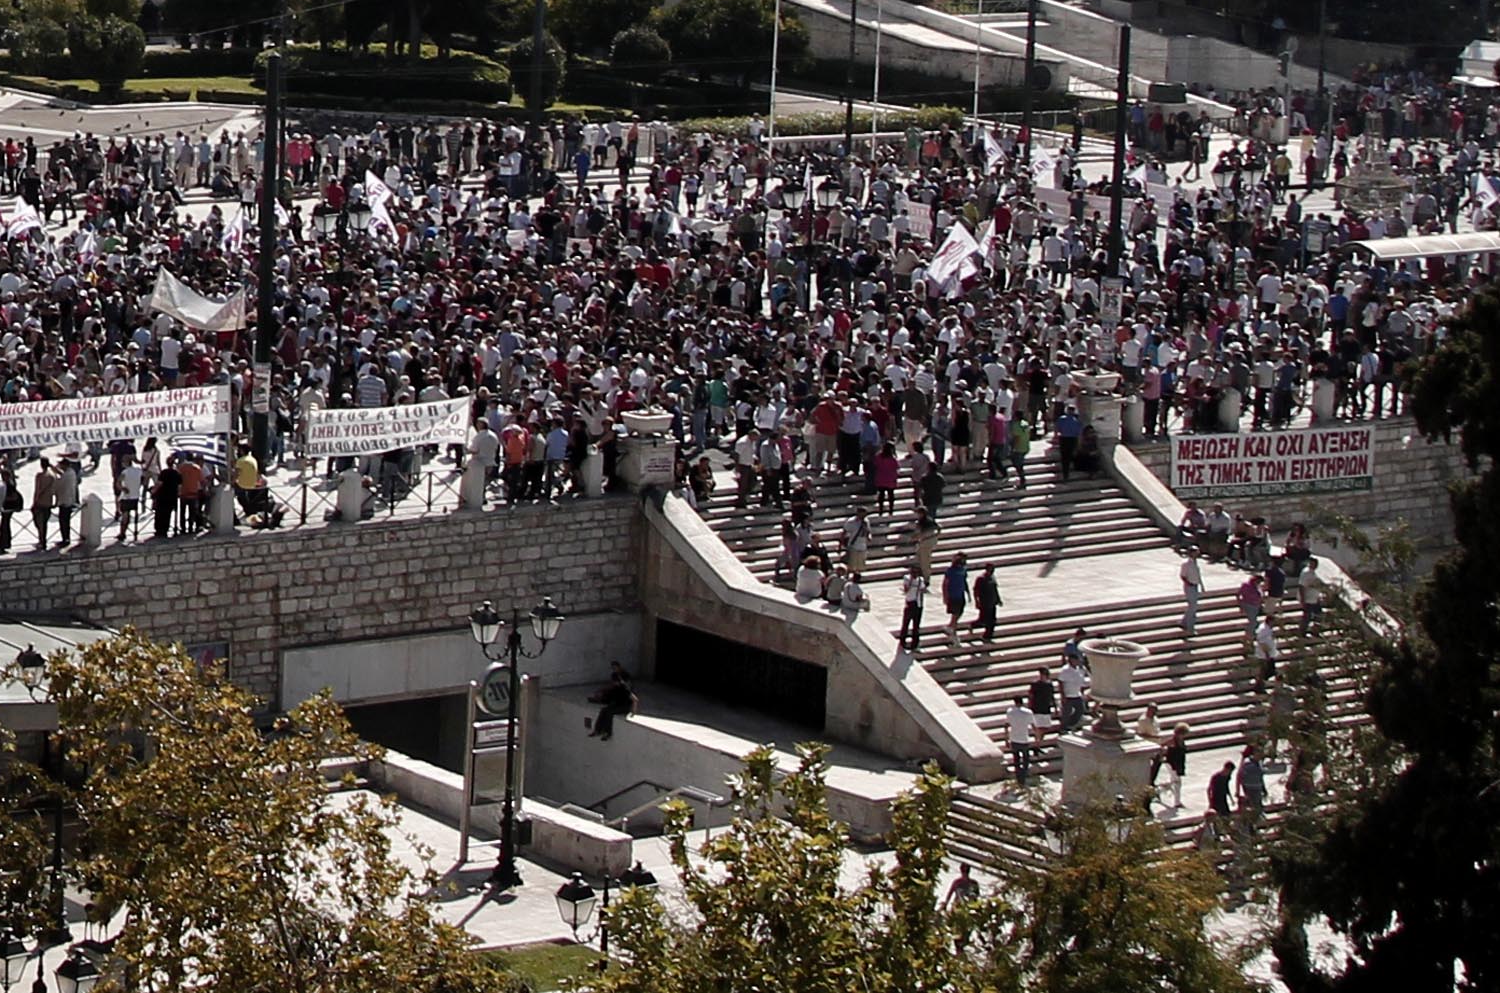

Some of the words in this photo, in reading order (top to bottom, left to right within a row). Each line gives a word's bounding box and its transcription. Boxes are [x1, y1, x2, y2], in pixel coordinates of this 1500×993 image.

[1178, 439, 1238, 460] ΜΕΙΩΣΗ
[1243, 436, 1271, 457] ΚΑΙ
[1276, 434, 1302, 455] ΟΧΙ
[1308, 430, 1370, 453] ΑΥΞΗΣΗ
[1177, 463, 1204, 485] ΤΗΣ
[1208, 462, 1253, 484] ΤΙΜΗΣ
[1257, 460, 1286, 481] ΤΩΝ
[1290, 455, 1368, 479] ΕΙΣΙΤΗΡΙΩΝ
